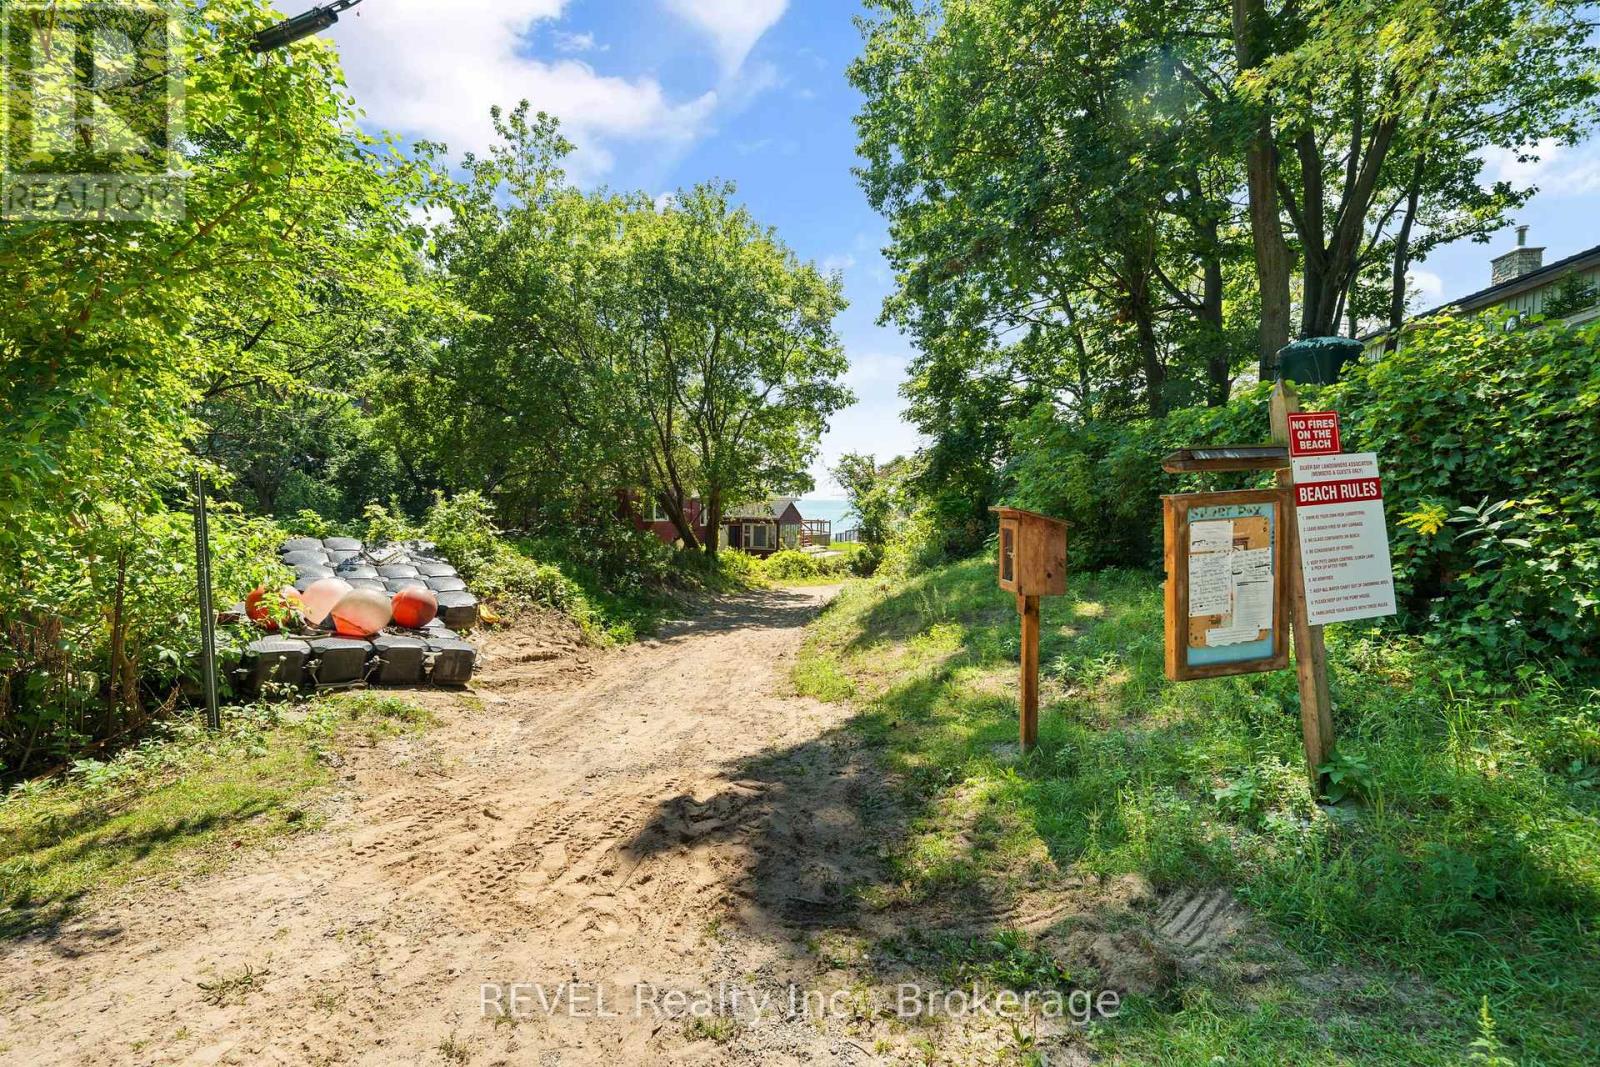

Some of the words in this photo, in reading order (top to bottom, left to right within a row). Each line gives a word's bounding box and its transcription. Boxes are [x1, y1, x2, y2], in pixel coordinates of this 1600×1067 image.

[1292, 420, 1306, 430] NO
[1308, 419, 1335, 429] FIRES
[1297, 430, 1311, 439] ON
[1313, 429, 1332, 438] THE
[1300, 439, 1332, 449] BEACH
[1300, 485, 1338, 502] BEACH
[1340, 482, 1377, 498] RULES
